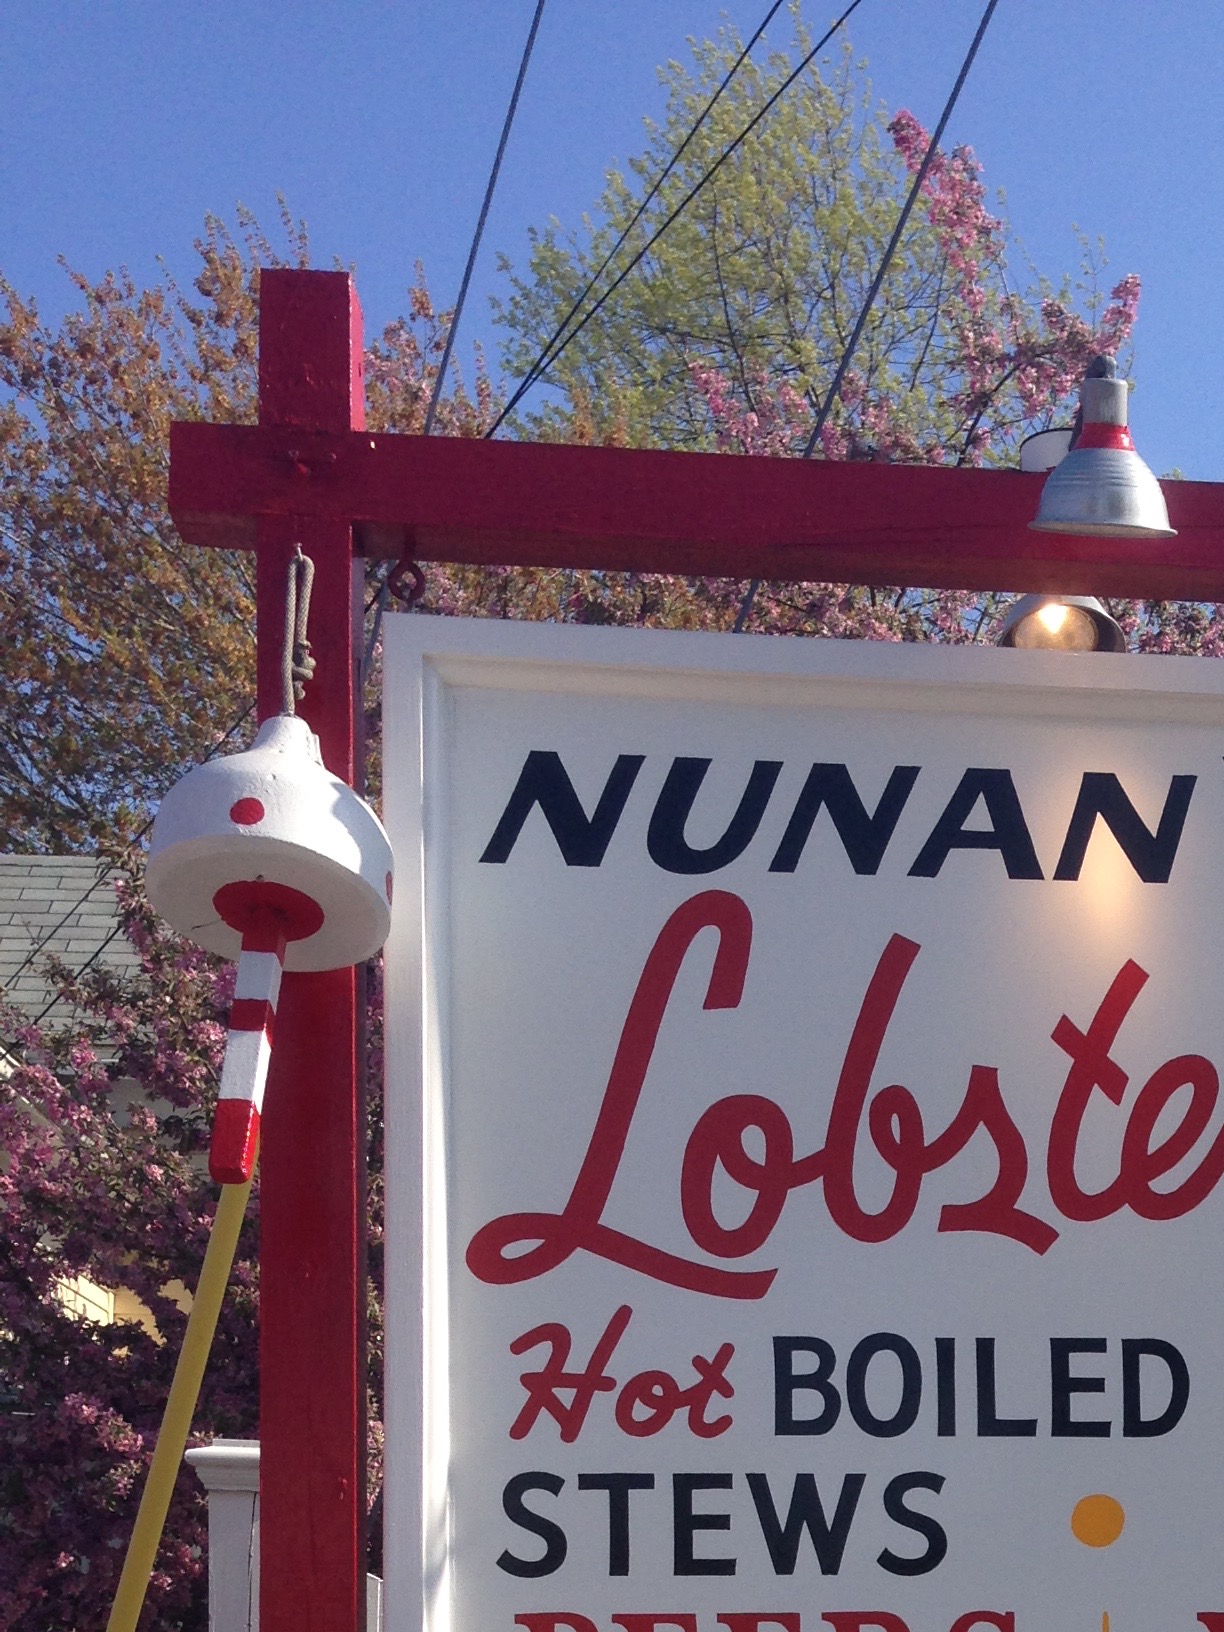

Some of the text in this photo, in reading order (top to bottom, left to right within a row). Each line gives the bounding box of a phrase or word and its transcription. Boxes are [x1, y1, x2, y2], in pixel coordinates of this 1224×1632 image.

[510, 1306, 735, 1443] Hot
[772, 1333, 1190, 1438] BOILED
[496, 1472, 948, 1578] STEWS
